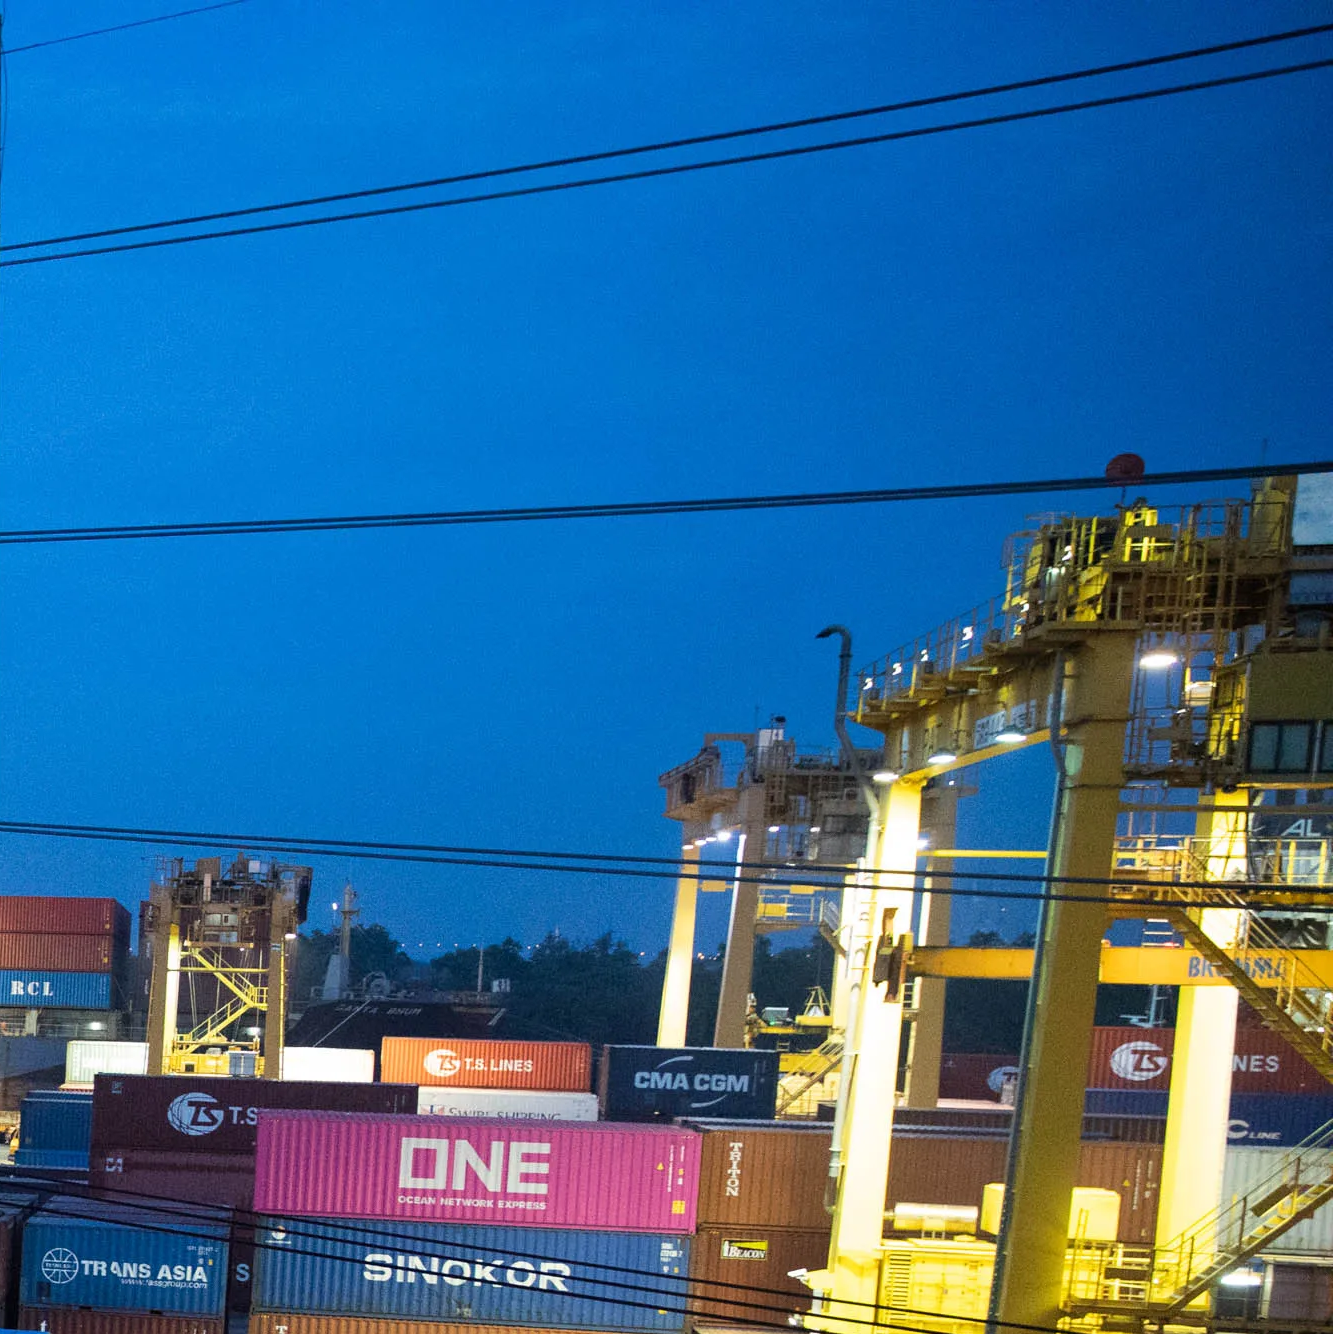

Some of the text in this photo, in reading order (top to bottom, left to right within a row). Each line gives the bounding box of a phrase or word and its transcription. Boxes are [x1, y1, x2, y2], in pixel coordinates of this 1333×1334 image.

[10, 980, 54, 996] RCL
[464, 1057, 488, 1071] T.S.
[490, 1059, 533, 1073] LINES
[1231, 1055, 1279, 1073] NES
[634, 1071, 749, 1093] CMA CGM
[398, 1137, 551, 1195] ONE
[726, 1142, 743, 1197] TRITON
[397, 1195, 546, 1210] OCEAN NETWORK EXPRESS
[729, 1246, 766, 1259] BEACON
[81, 1260, 208, 1283] TRANS ASIA
[363, 1253, 571, 1291] SINOKOR
